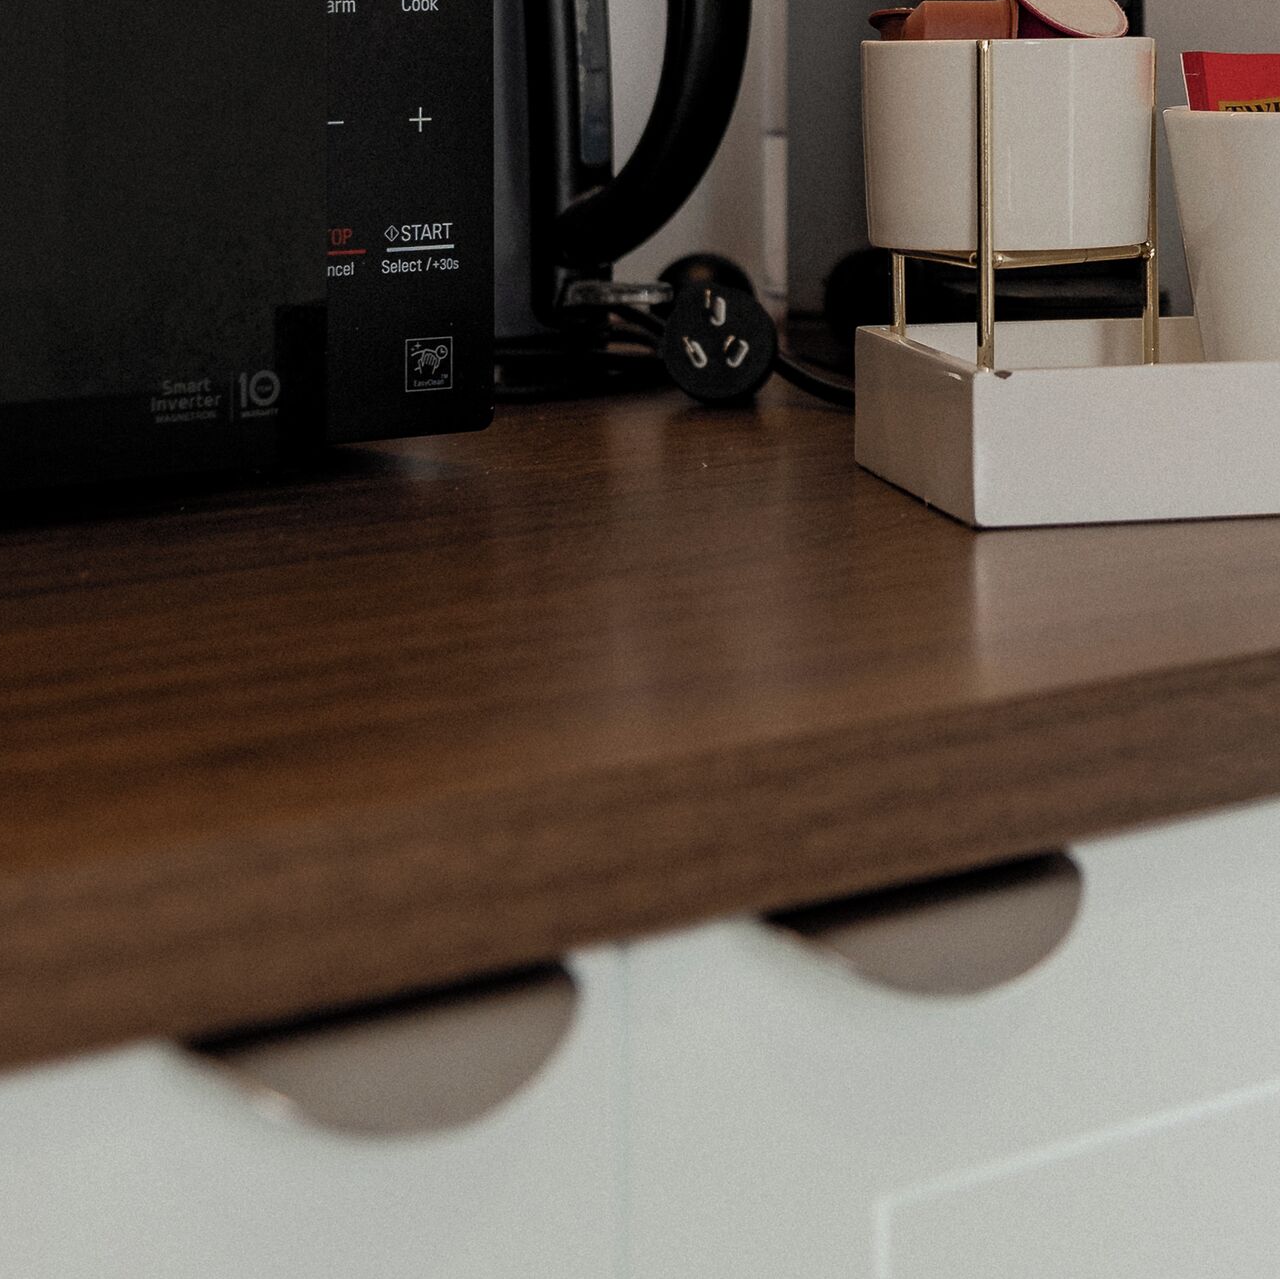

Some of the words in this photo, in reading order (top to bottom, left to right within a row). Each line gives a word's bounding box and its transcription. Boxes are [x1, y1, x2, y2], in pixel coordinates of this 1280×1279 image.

[401, 223, 453, 241] START
[381, 258, 422, 274] Select
[162, 377, 212, 395] Smart
[238, 370, 281, 408] 10
[150, 394, 222, 413] Inverter
